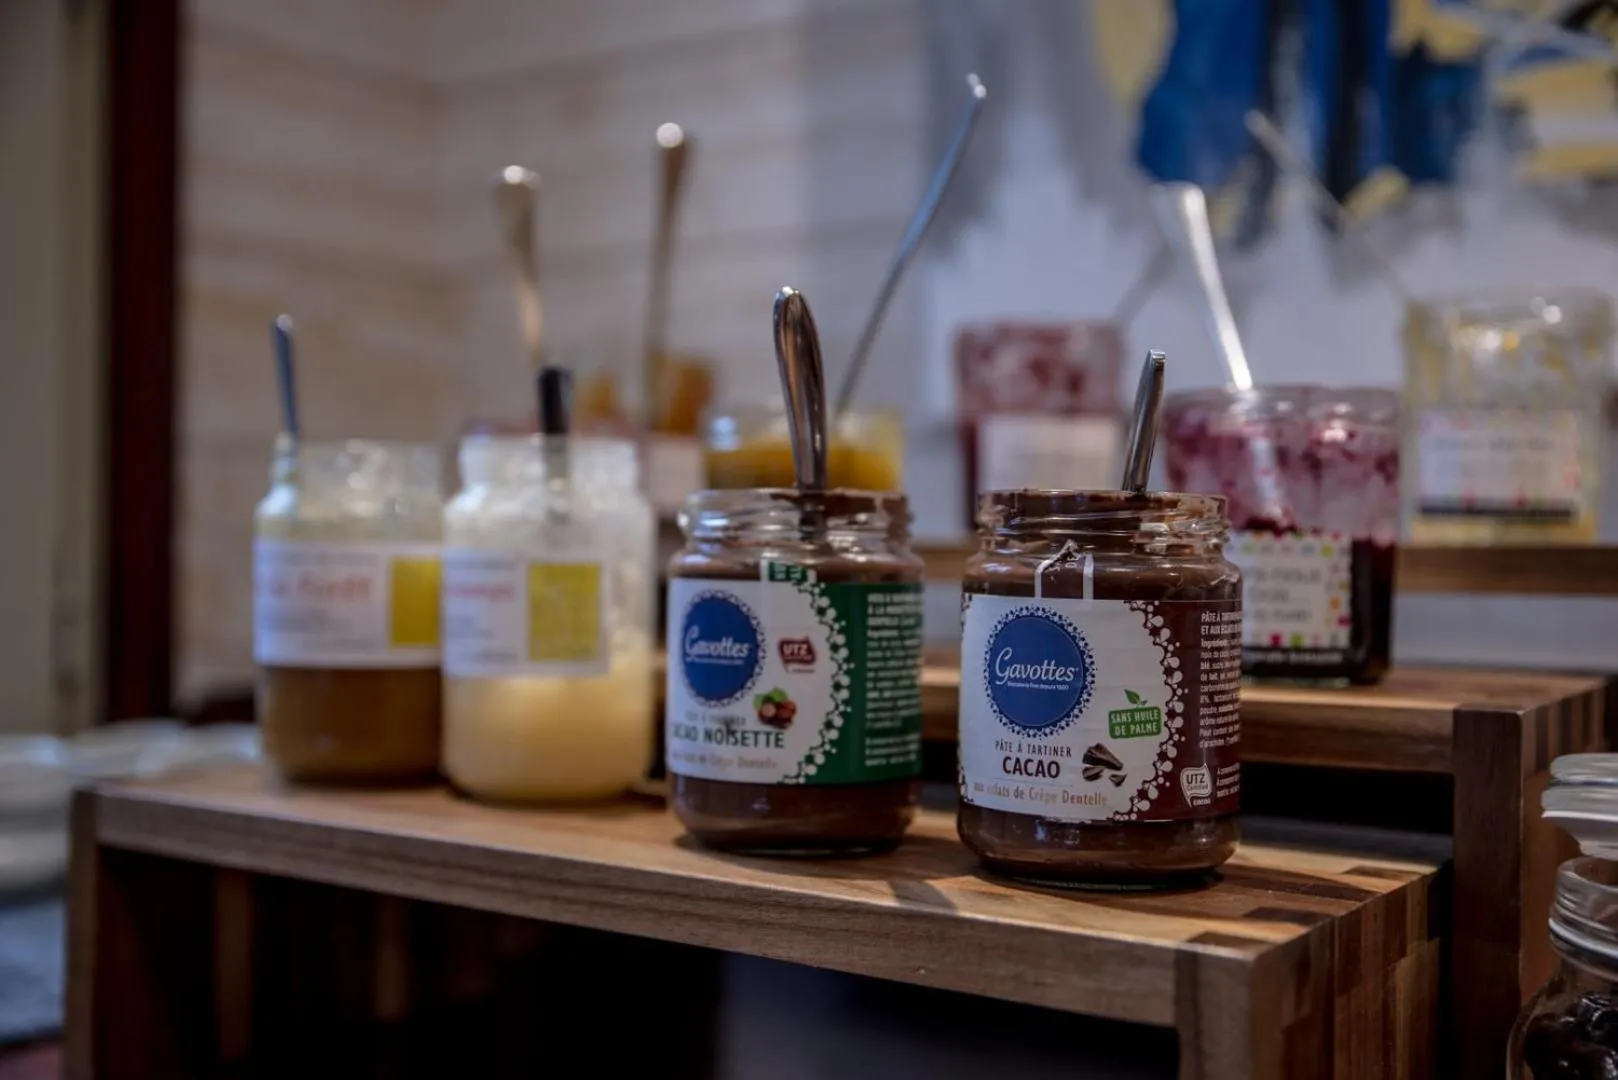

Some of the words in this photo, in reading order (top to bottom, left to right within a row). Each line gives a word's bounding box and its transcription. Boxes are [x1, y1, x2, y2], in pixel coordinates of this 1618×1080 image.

[685, 625, 750, 662] Gavottes
[782, 643, 808, 656] UTZ
[995, 647, 1076, 685] Gavottes
[1110, 712, 1131, 724] SANS
[1134, 708, 1159, 722] HUILE
[703, 728, 785, 749] NOISETTE
[1114, 725, 1126, 736] DE
[1130, 721, 1158, 735] PALME
[995, 738, 1013, 753] PÂTE
[1028, 743, 1072, 758] TARTINER
[1002, 756, 1061, 779] CACAO
[1186, 773, 1206, 785] UTZ
[1013, 785, 1026, 799] de
[1062, 789, 1109, 806] Dentelle
